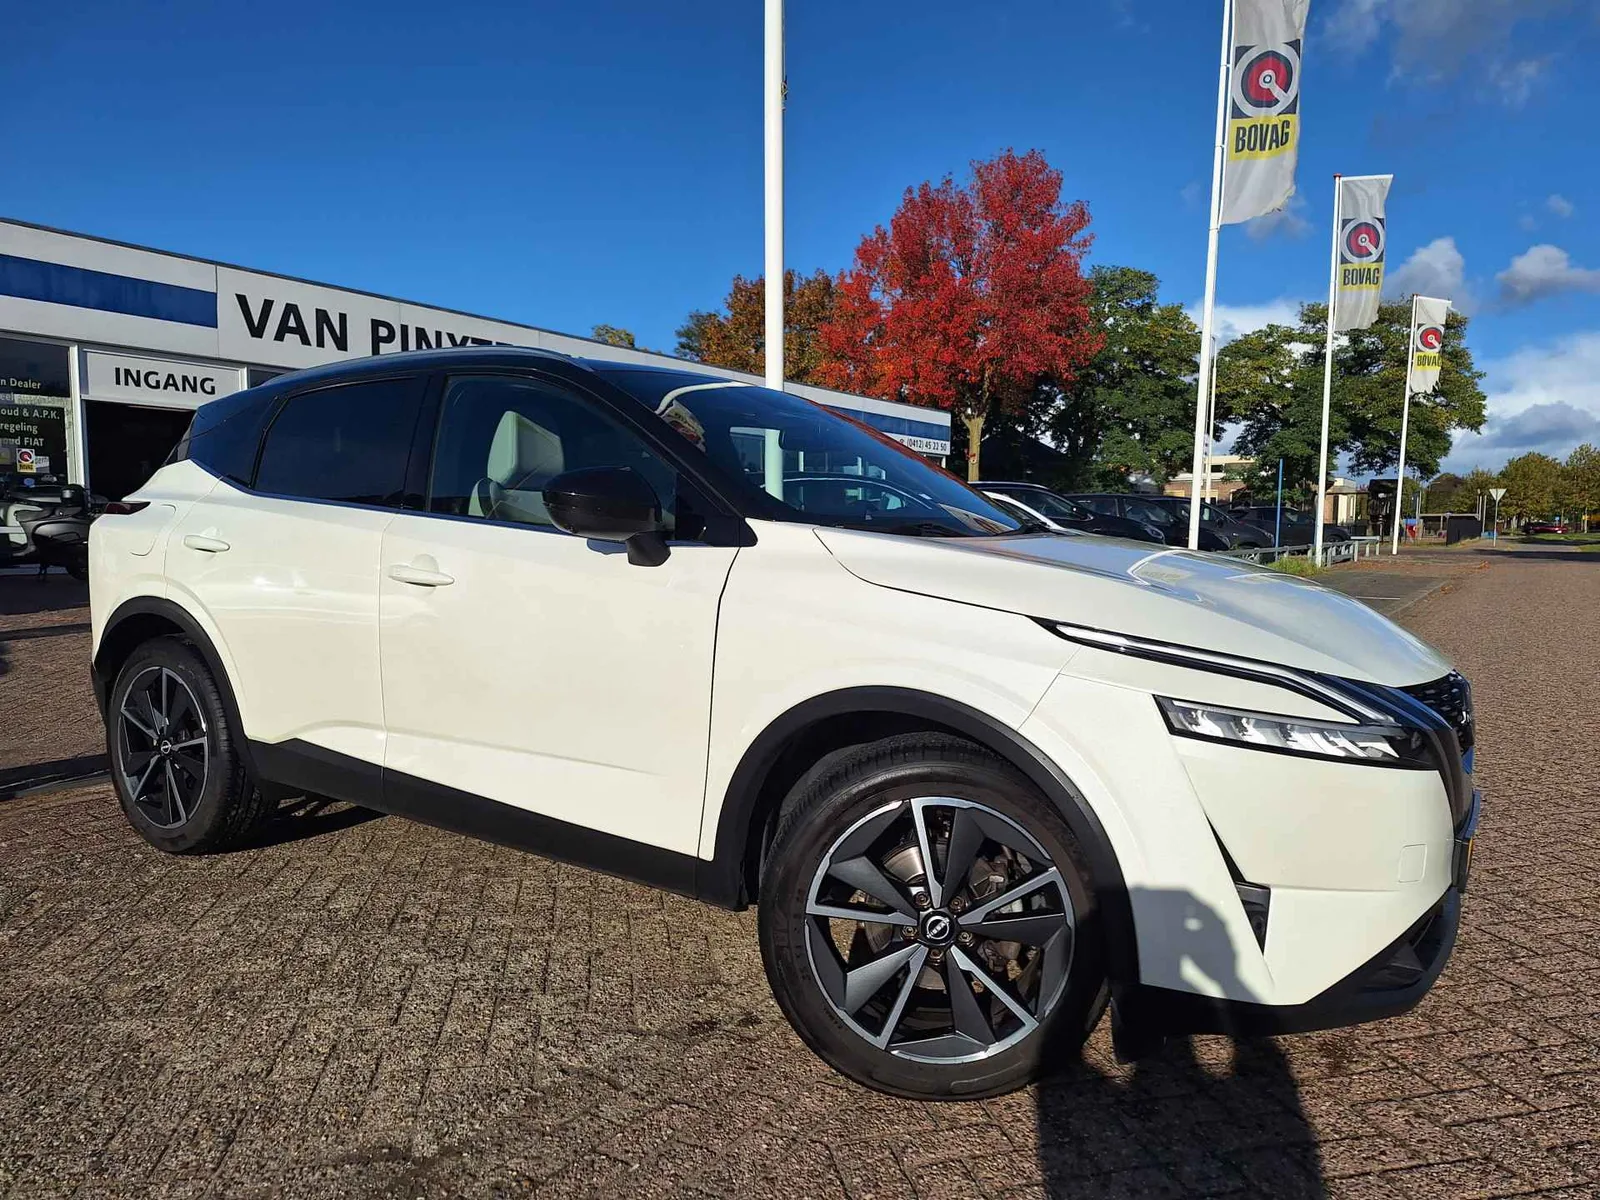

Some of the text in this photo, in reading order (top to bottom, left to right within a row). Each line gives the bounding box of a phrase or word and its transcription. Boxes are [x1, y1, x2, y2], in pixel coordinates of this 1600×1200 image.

[1235, 120, 1290, 153] BOVAG
[1343, 267, 1380, 286] BOVAG
[235, 293, 348, 352] VAN
[9, 378, 42, 389] Dealer
[114, 367, 216, 395] INGANG
[22, 408, 30, 417] &
[32, 409, 60, 420] A.P.K.
[0, 422, 38, 435] regeling
[0, 436, 44, 447] oud FIAT
